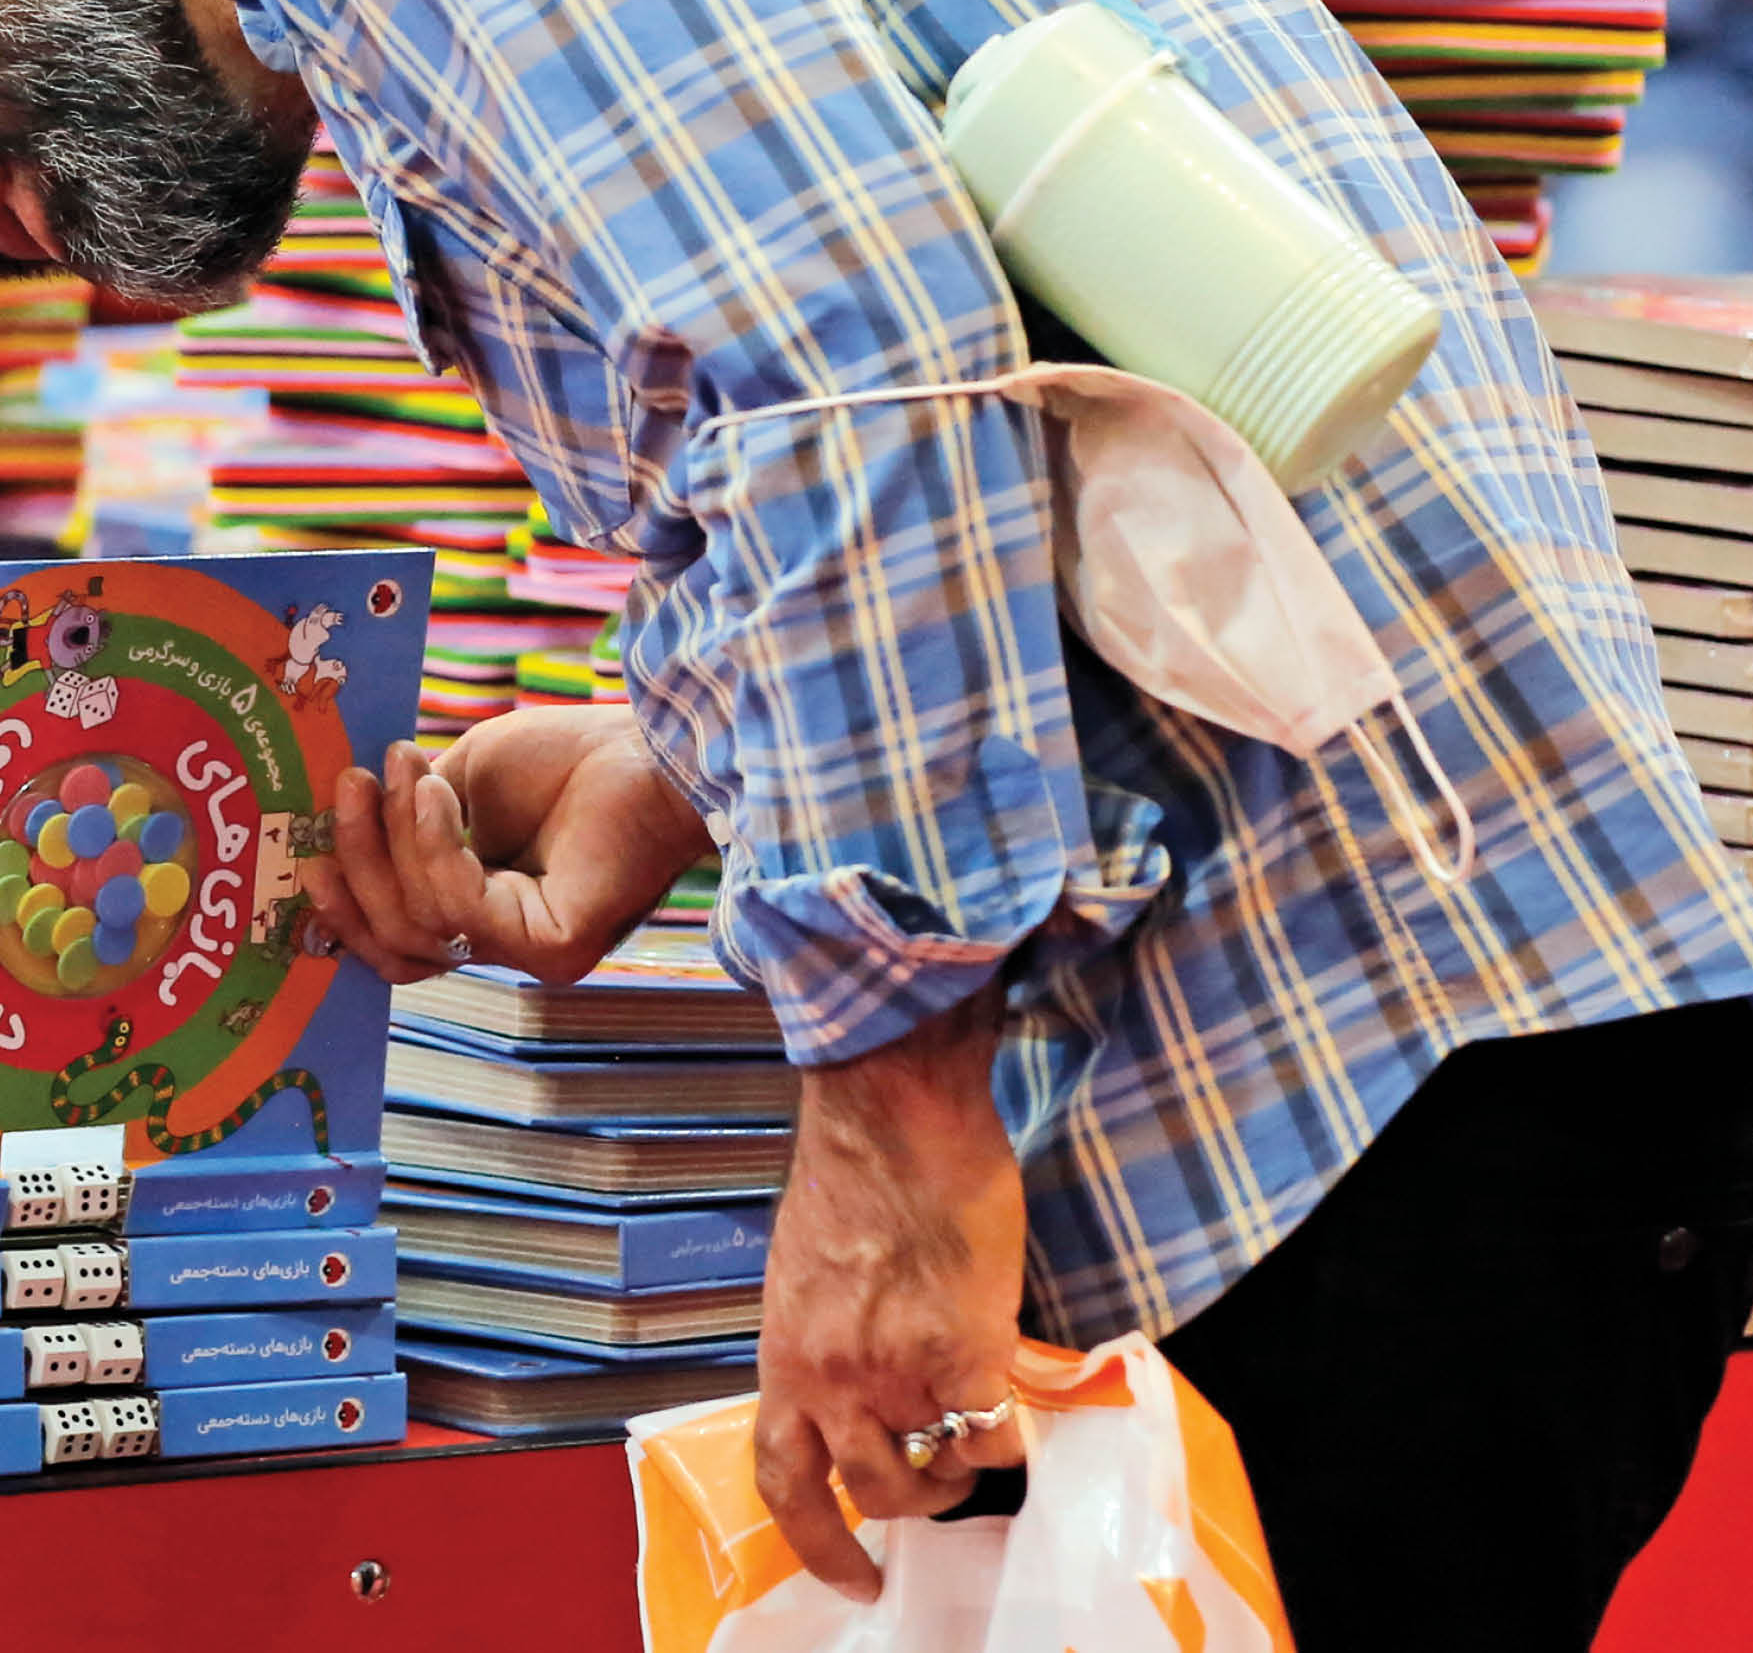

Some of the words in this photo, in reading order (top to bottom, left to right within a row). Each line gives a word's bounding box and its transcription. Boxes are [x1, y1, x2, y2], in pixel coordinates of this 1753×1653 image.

[128, 640, 191, 667] سرگرمی
[186, 661, 199, 676] و
[197, 670, 232, 700] بازی
[230, 683, 258, 715] ۵
